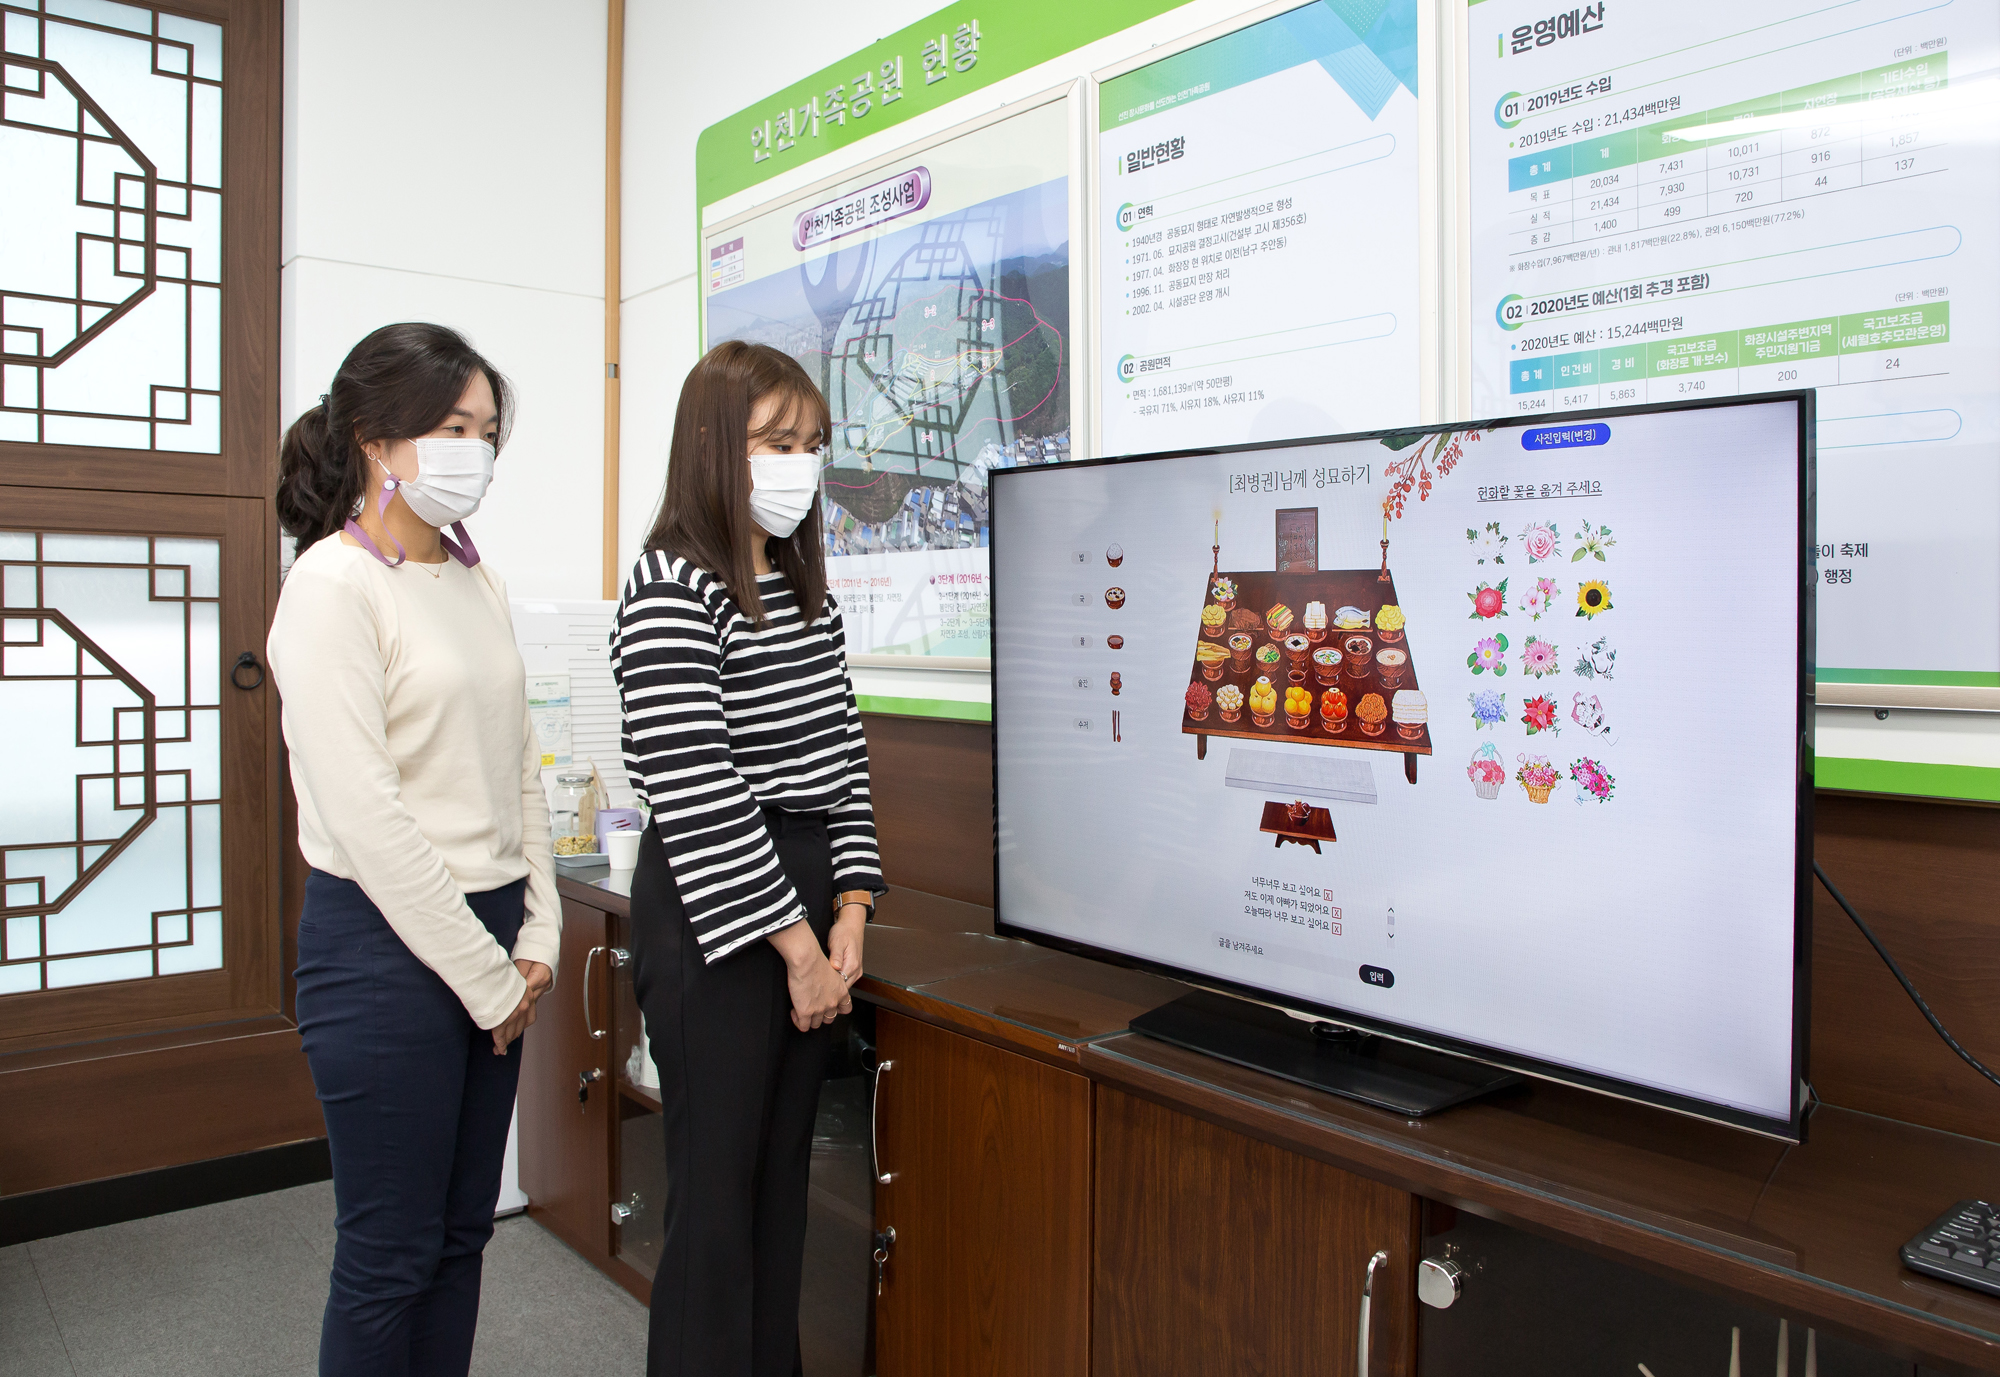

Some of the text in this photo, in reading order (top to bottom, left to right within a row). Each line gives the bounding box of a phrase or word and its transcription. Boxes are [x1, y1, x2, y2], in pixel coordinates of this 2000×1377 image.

[1511, 2, 1605, 55] 운영예산
[1894, 37, 1947, 58] (단위 백만원)
[1880, 63, 1929, 84] 기타수입
[751, 18, 983, 163] 인천가족공원 현황
[1156, 94, 1176, 108] 선도하는
[1177, 82, 1210, 101] 인천가족공원
[1504, 76, 1612, 117] 01 2019년도 수입
[1519, 95, 1681, 148] 2019년도 수입 21,434백만원
[1810, 126, 1830, 139] 872
[1889, 132, 1920, 148] 1,857
[1126, 135, 1186, 174] 일반현황
[1600, 147, 1610, 159] 계
[1727, 142, 1760, 158] 10,011
[1810, 150, 1831, 164] 916
[1659, 160, 1684, 174] 7,431
[1894, 158, 1915, 172] 137
[1590, 174, 1620, 189] 20,034
[1727, 166, 1760, 182] 10,731
[1814, 176, 1828, 187] 44
[1659, 182, 1685, 196] 7,930
[1590, 196, 1620, 211] 21,434
[1735, 191, 1753, 204] 720
[803, 178, 915, 240] 인천가족공원 조성사업
[1122, 205, 1154, 223] 01 연혁
[1663, 206, 1681, 217] 499
[1132, 196, 1293, 248] 1940년경 공동묘지 형태로 자연발생적으로 형성
[1594, 218, 1617, 233] 1,400
[1132, 212, 1307, 265] 1971. 06. 묘지공원 결정고시(건설부 고시 제356호)
[1705, 226, 1720, 237] 관외
[1132, 236, 1288, 282] 1977. 04. 화장장 현 위치로 이전(남구 주안동)
[1132, 267, 1230, 299] 1996. 11. 공동묘지 만장 처리
[1132, 286, 1230, 317] 2002. 04. 시설공단 운영 개시
[1506, 272, 1710, 320] 02 2020년도 예산(1회 추경 포함)
[1895, 286, 1949, 302] (단위 백만원)
[1863, 311, 1924, 330] 국고보조금
[1521, 317, 1683, 352] 2020년도 예산 15,244백만원
[1744, 324, 1832, 346] 화장시설주변지역
[1841, 324, 1947, 349] (세월호추모관운영)
[1667, 340, 1717, 356] 국고보조금
[1755, 339, 1821, 359] 주민지원기금
[1123, 355, 1172, 375] 02 공원면적
[1560, 362, 1592, 377] 인건비
[1656, 357, 1689, 372] (화장로
[1885, 358, 1900, 370] 24
[1777, 369, 1798, 382] 200
[1132, 388, 1147, 401] 면적
[1205, 375, 1233, 390] 50만평)
[1610, 389, 1636, 401] 5,863
[1678, 380, 1706, 394] 3,740
[1138, 389, 1265, 417] 국유지 71%, 시유지 18%, 사유지 11%
[1518, 399, 1546, 411] 15,244
[1564, 394, 1589, 406] 5,417
[1534, 429, 1596, 445] 사진입력(변경)
[1229, 464, 1370, 494] [최병권]님께 성묘하기
[1477, 480, 1603, 500] 헌화할 꽃을 옮겨 주세요
[1840, 543, 1869, 558] 축제
[937, 573, 982, 585] 3단계 (2016년
[1824, 568, 1852, 584] 행정
[1252, 876, 1321, 897] 너무너무 보고 싶어요
[1244, 890, 1330, 915] 저도 이제 아빠가 되었어요
[1244, 905, 1330, 930] 오늘따라 너무 보고 싶어요
[1218, 937, 1264, 955] 글을 남겨주세요
[1369, 971, 1384, 984] 입력
